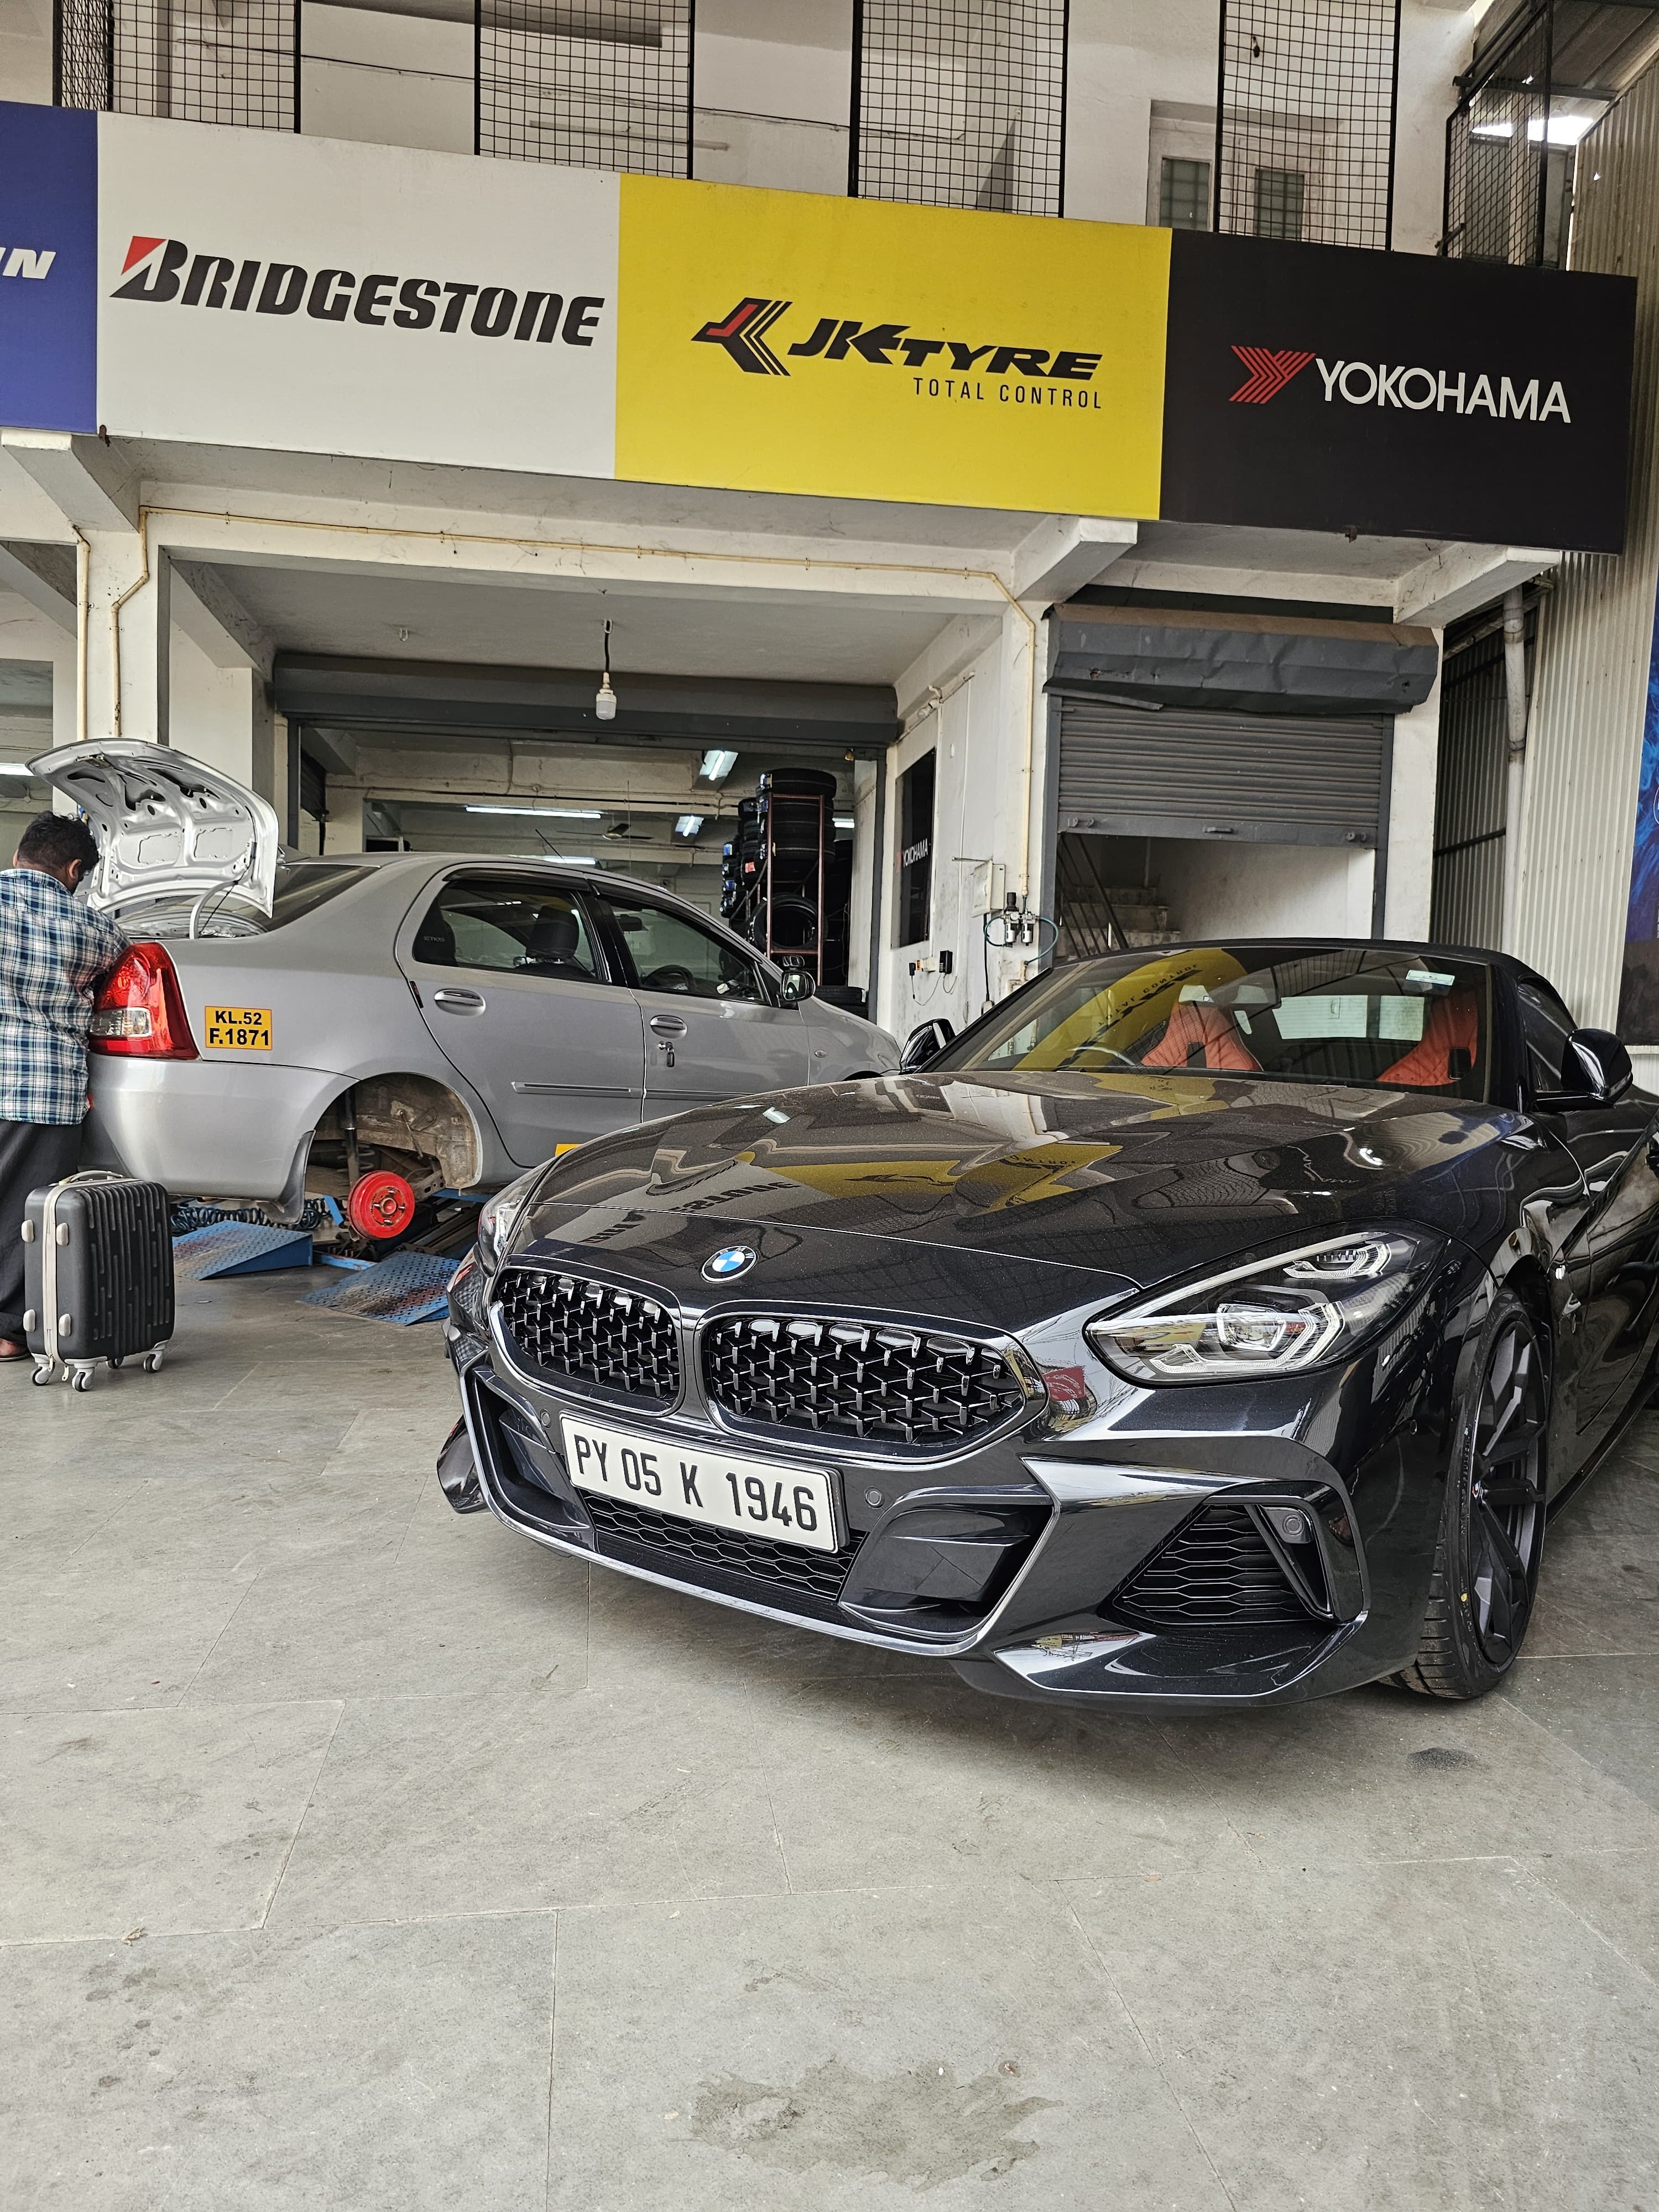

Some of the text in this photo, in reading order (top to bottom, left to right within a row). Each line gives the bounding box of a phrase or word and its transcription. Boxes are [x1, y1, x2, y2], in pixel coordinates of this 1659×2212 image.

[0, 247, 56, 279] N
[109, 236, 605, 346] BRIDGESTONE
[913, 378, 1102, 409] TOTAL CONTROL
[1316, 358, 1571, 423] YOKOHAMA
[215, 1010, 262, 1025] KL.52
[210, 1027, 269, 1046] F.1871
[574, 1434, 818, 1531] PY 05 K 1946
